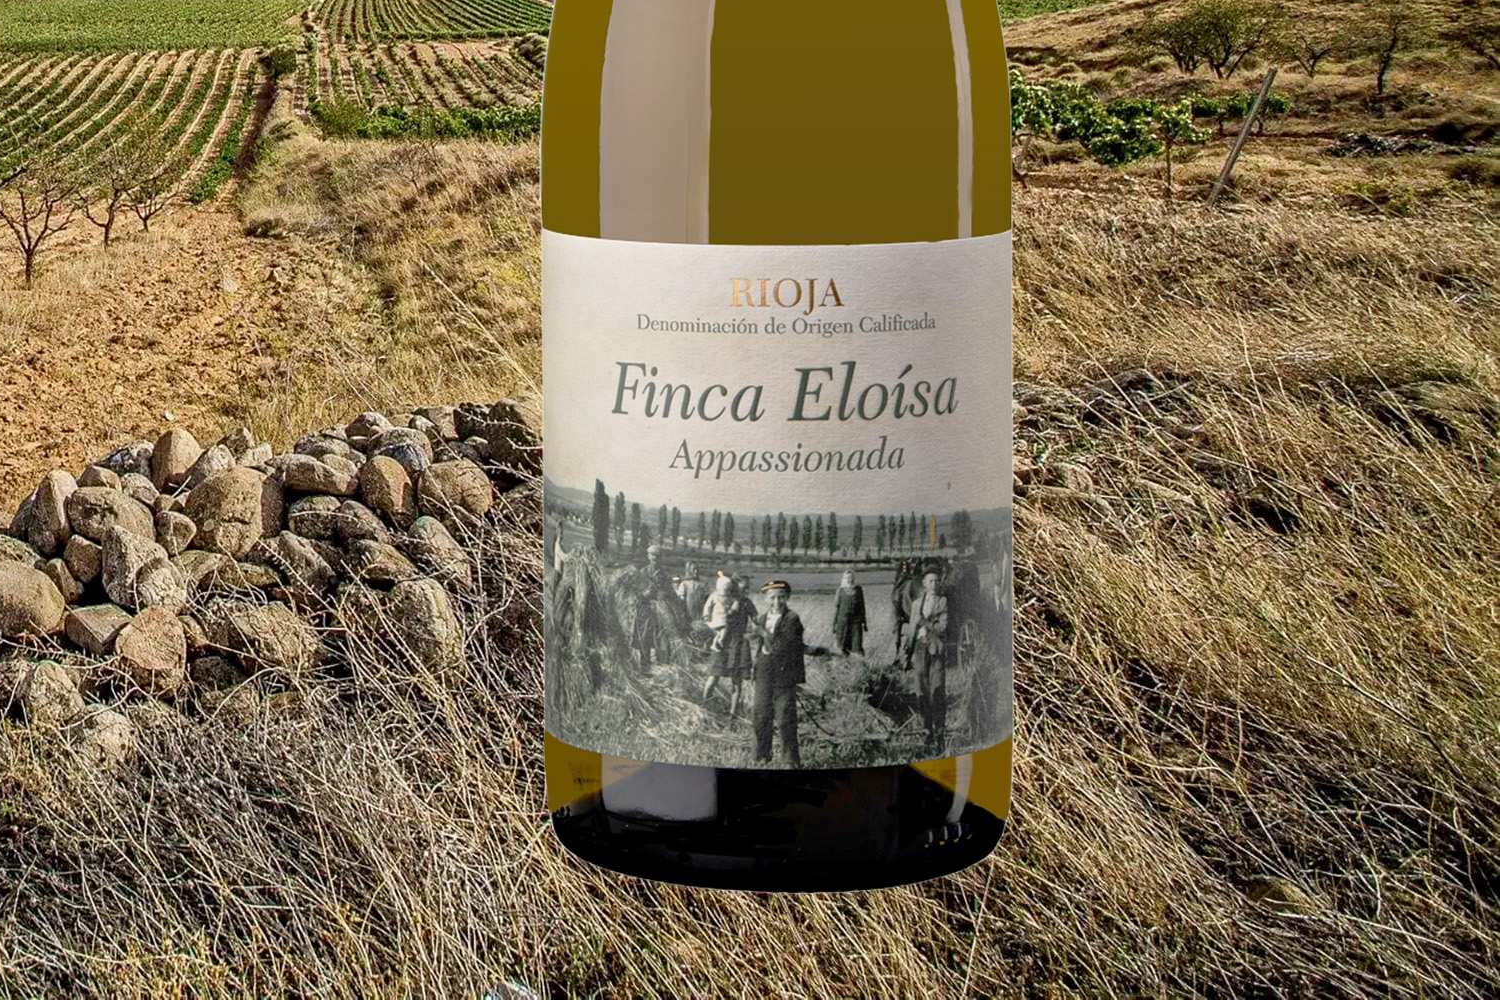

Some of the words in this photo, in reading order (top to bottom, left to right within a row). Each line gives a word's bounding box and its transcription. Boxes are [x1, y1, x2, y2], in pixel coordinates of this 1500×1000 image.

[729, 277, 845, 316] RIOJA
[636, 313, 759, 335] Denominación
[763, 316, 787, 335] de
[791, 317, 854, 338] Origen
[858, 312, 937, 333] Calificada
[611, 360, 766, 422] Finca
[786, 360, 961, 422] Eloísa
[668, 435, 906, 480] Appassionada
